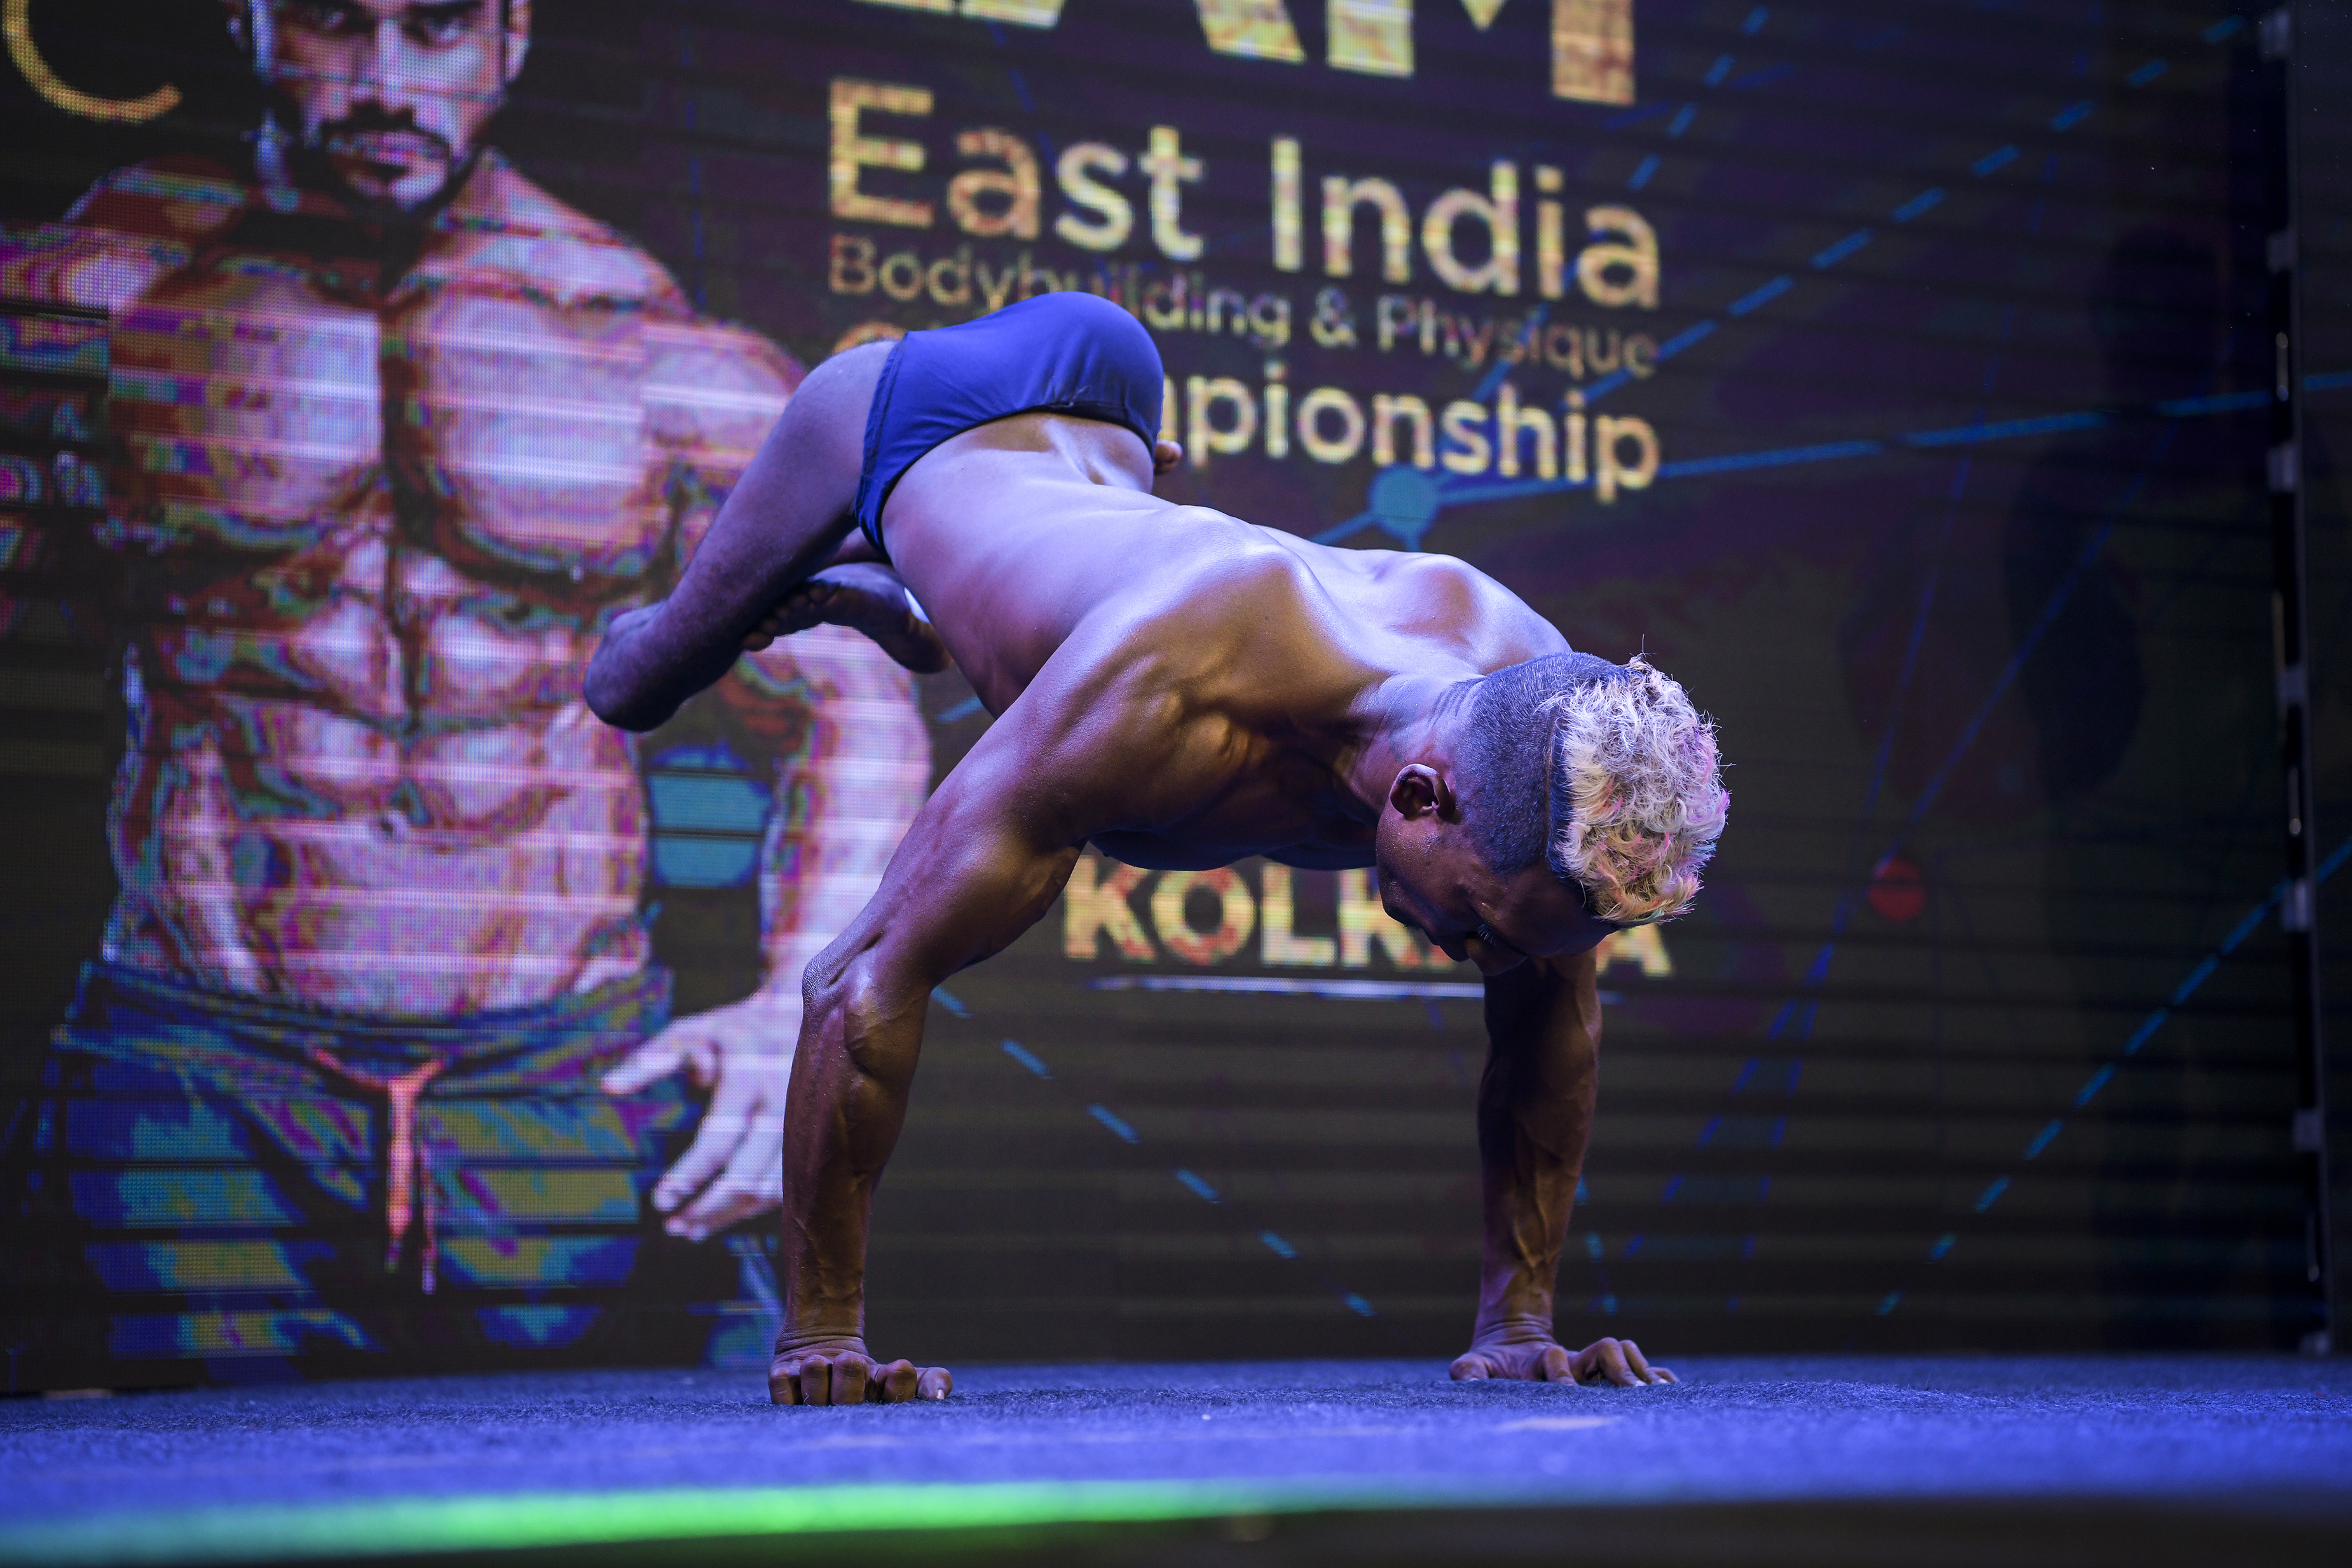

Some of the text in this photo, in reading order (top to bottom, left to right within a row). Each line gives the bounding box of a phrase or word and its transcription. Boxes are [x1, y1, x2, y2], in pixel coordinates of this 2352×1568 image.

[829, 75, 1660, 310] East India
[1309, 286, 1357, 349] &
[1375, 294, 1660, 380] Physique
[1063, 854, 1673, 979] KOLKA
